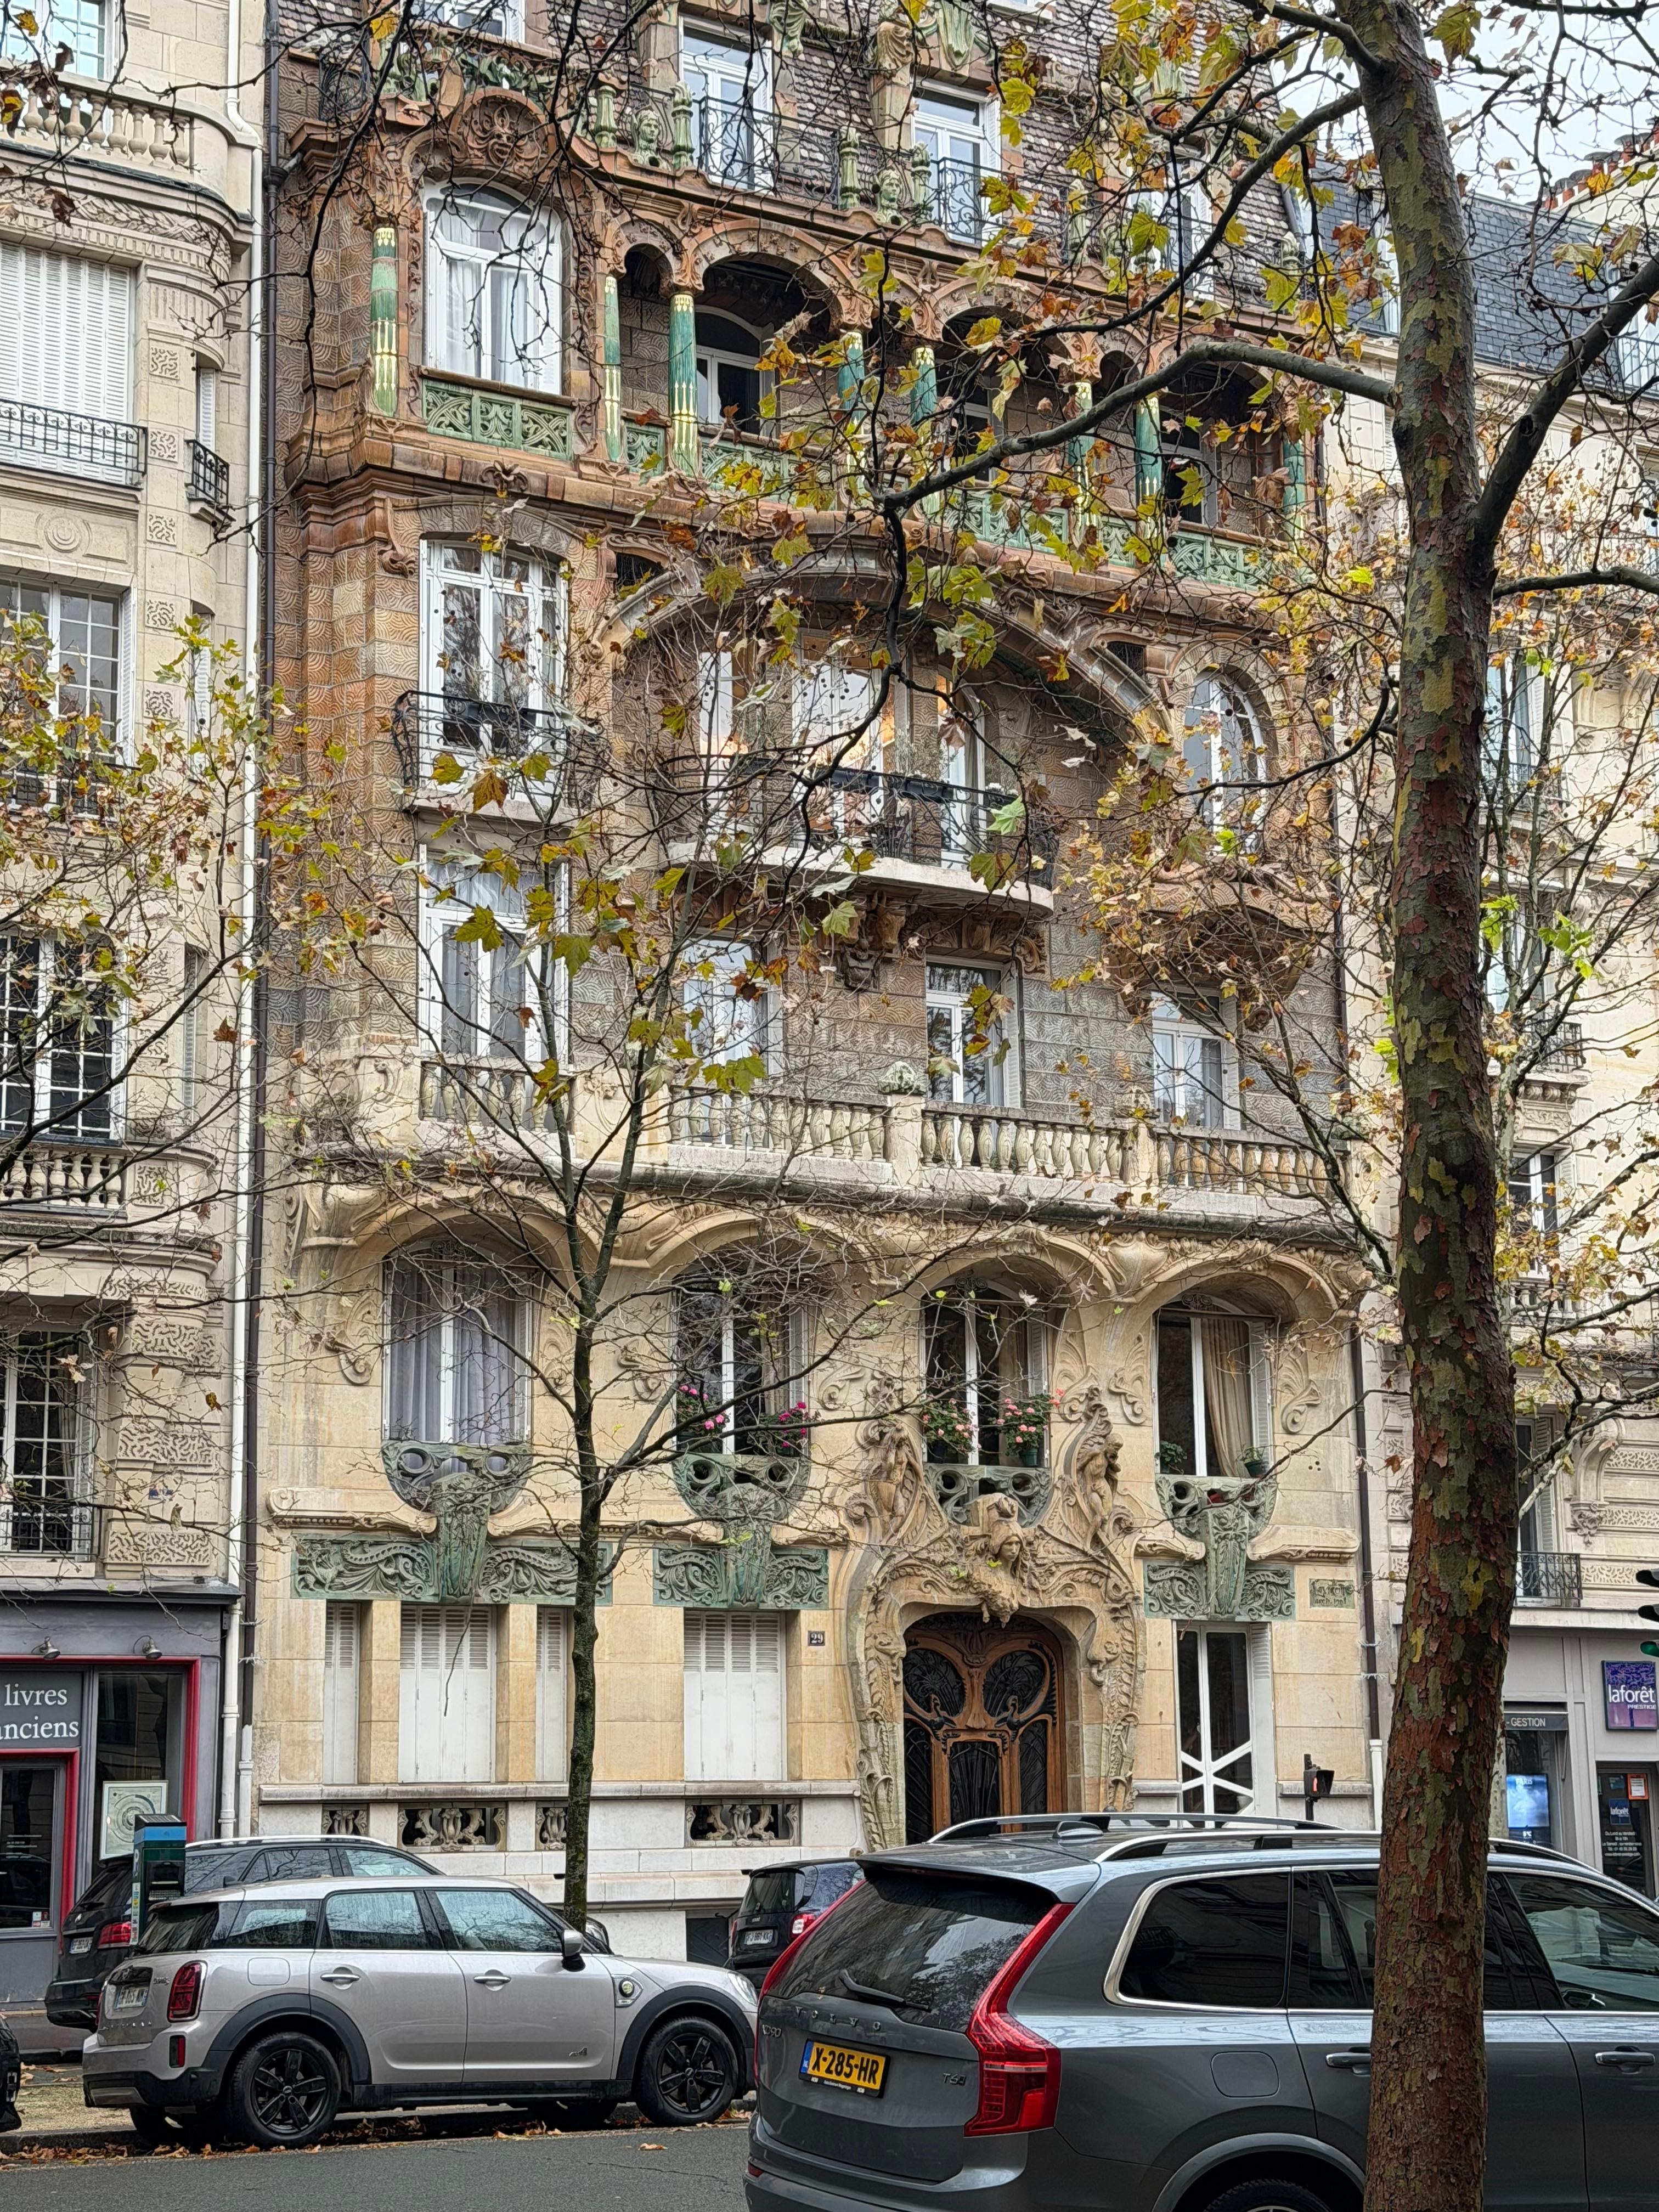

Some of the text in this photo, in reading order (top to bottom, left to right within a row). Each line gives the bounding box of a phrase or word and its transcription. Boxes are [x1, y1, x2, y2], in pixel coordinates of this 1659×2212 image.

[811, 1633, 823, 1644] 29
[4, 1683, 67, 1706] livres
[1608, 1684, 1656, 1703] laforêt
[0, 1716, 79, 1740] nciens
[1511, 1718, 1546, 1727] GESTION
[795, 2006, 882, 2031] VOLVO
[811, 2047, 880, 2085] X-285-HR
